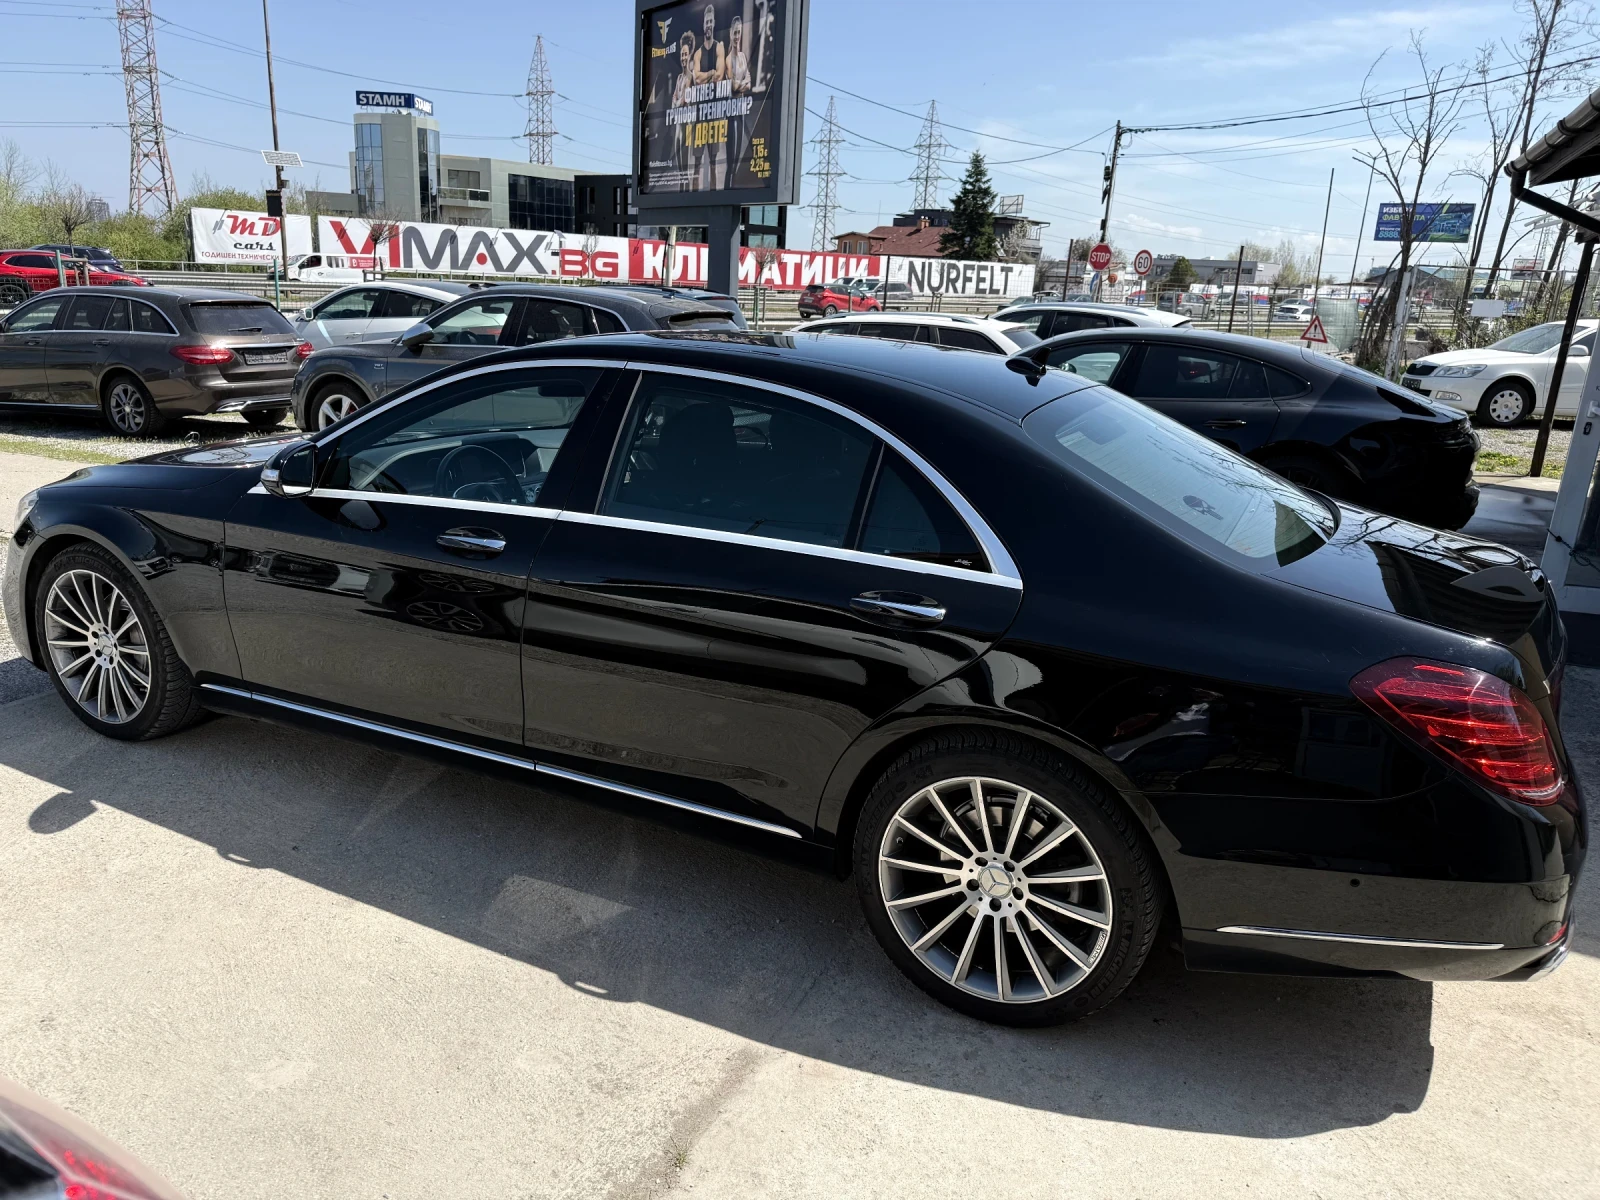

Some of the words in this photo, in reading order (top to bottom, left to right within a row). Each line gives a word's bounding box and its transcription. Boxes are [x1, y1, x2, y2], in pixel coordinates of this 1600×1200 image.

[685, 82, 714, 103] ФИТНЕС
[715, 80, 732, 98] ИЛИ
[359, 93, 405, 106] STAMH
[666, 106, 697, 126] ГРУПОВИ
[698, 96, 753, 120] ТРЕНИРОВКИ?
[685, 122, 692, 146] И
[694, 120, 728, 148] ДВЕТЕ!
[233, 242, 276, 251] cars
[201, 251, 236, 259] ГОДИШЕН
[238, 252, 280, 261] ТЕХНИЧЕСКИ
[1091, 252, 1110, 262] STOP
[1137, 256, 1149, 269] 60
[907, 260, 1014, 295] NURFELT
